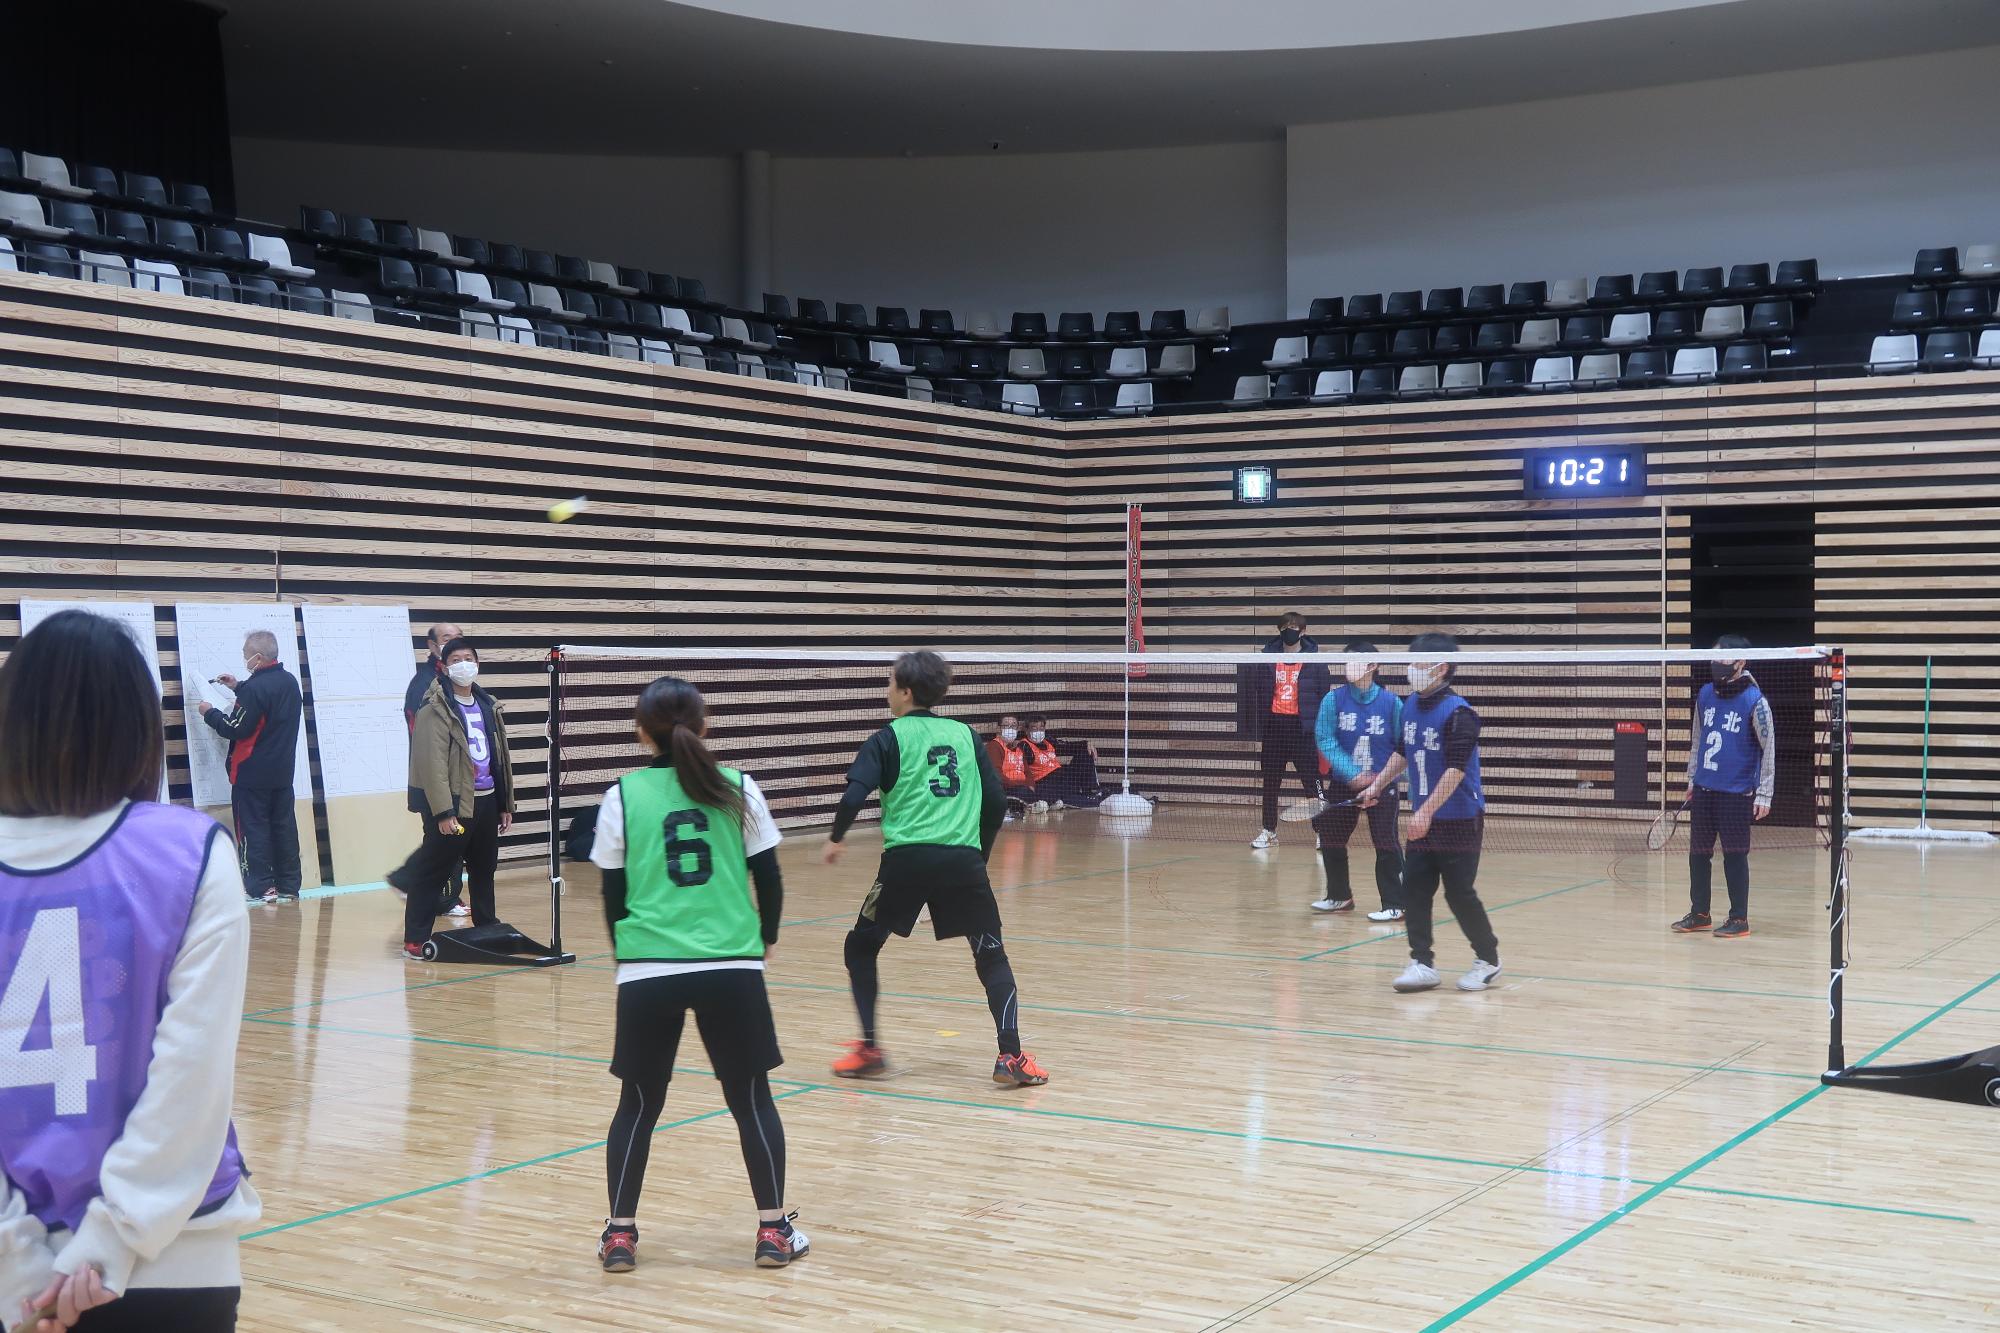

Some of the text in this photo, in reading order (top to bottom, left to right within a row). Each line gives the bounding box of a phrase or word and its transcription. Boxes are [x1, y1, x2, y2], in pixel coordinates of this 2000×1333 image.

[1548, 458, 1628, 486] 10:21
[1280, 684, 1293, 700] 2
[465, 712, 487, 761] 5
[1352, 735, 1374, 771] 4
[1703, 730, 1723, 772] 2
[927, 744, 960, 798] 3
[1414, 749, 1429, 796] 1
[663, 808, 714, 888] 6
[0, 906, 97, 1116] 4
